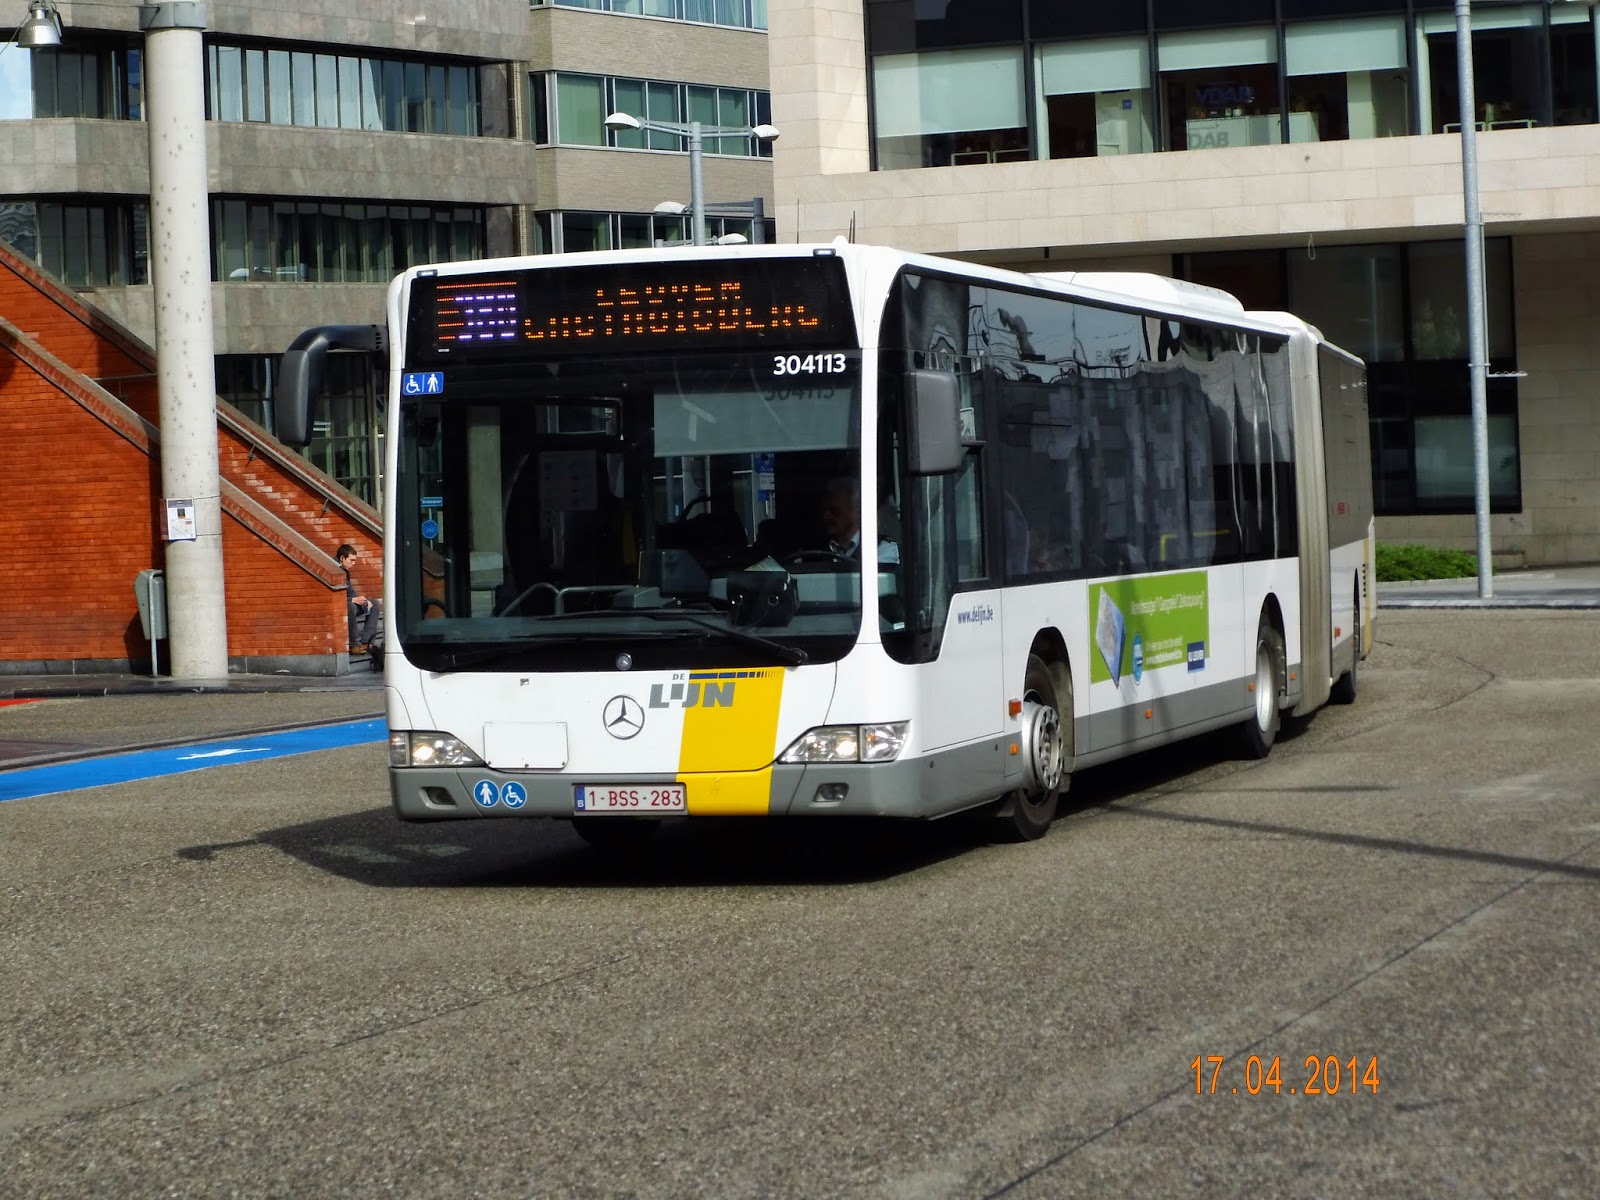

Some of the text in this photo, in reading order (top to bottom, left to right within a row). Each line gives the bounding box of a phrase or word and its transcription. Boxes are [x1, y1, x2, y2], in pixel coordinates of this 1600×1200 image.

[773, 353, 846, 376] 304113
[672, 673, 685, 681] DE
[648, 682, 736, 709] LIJN
[589, 790, 682, 807] 1-BSS-283
